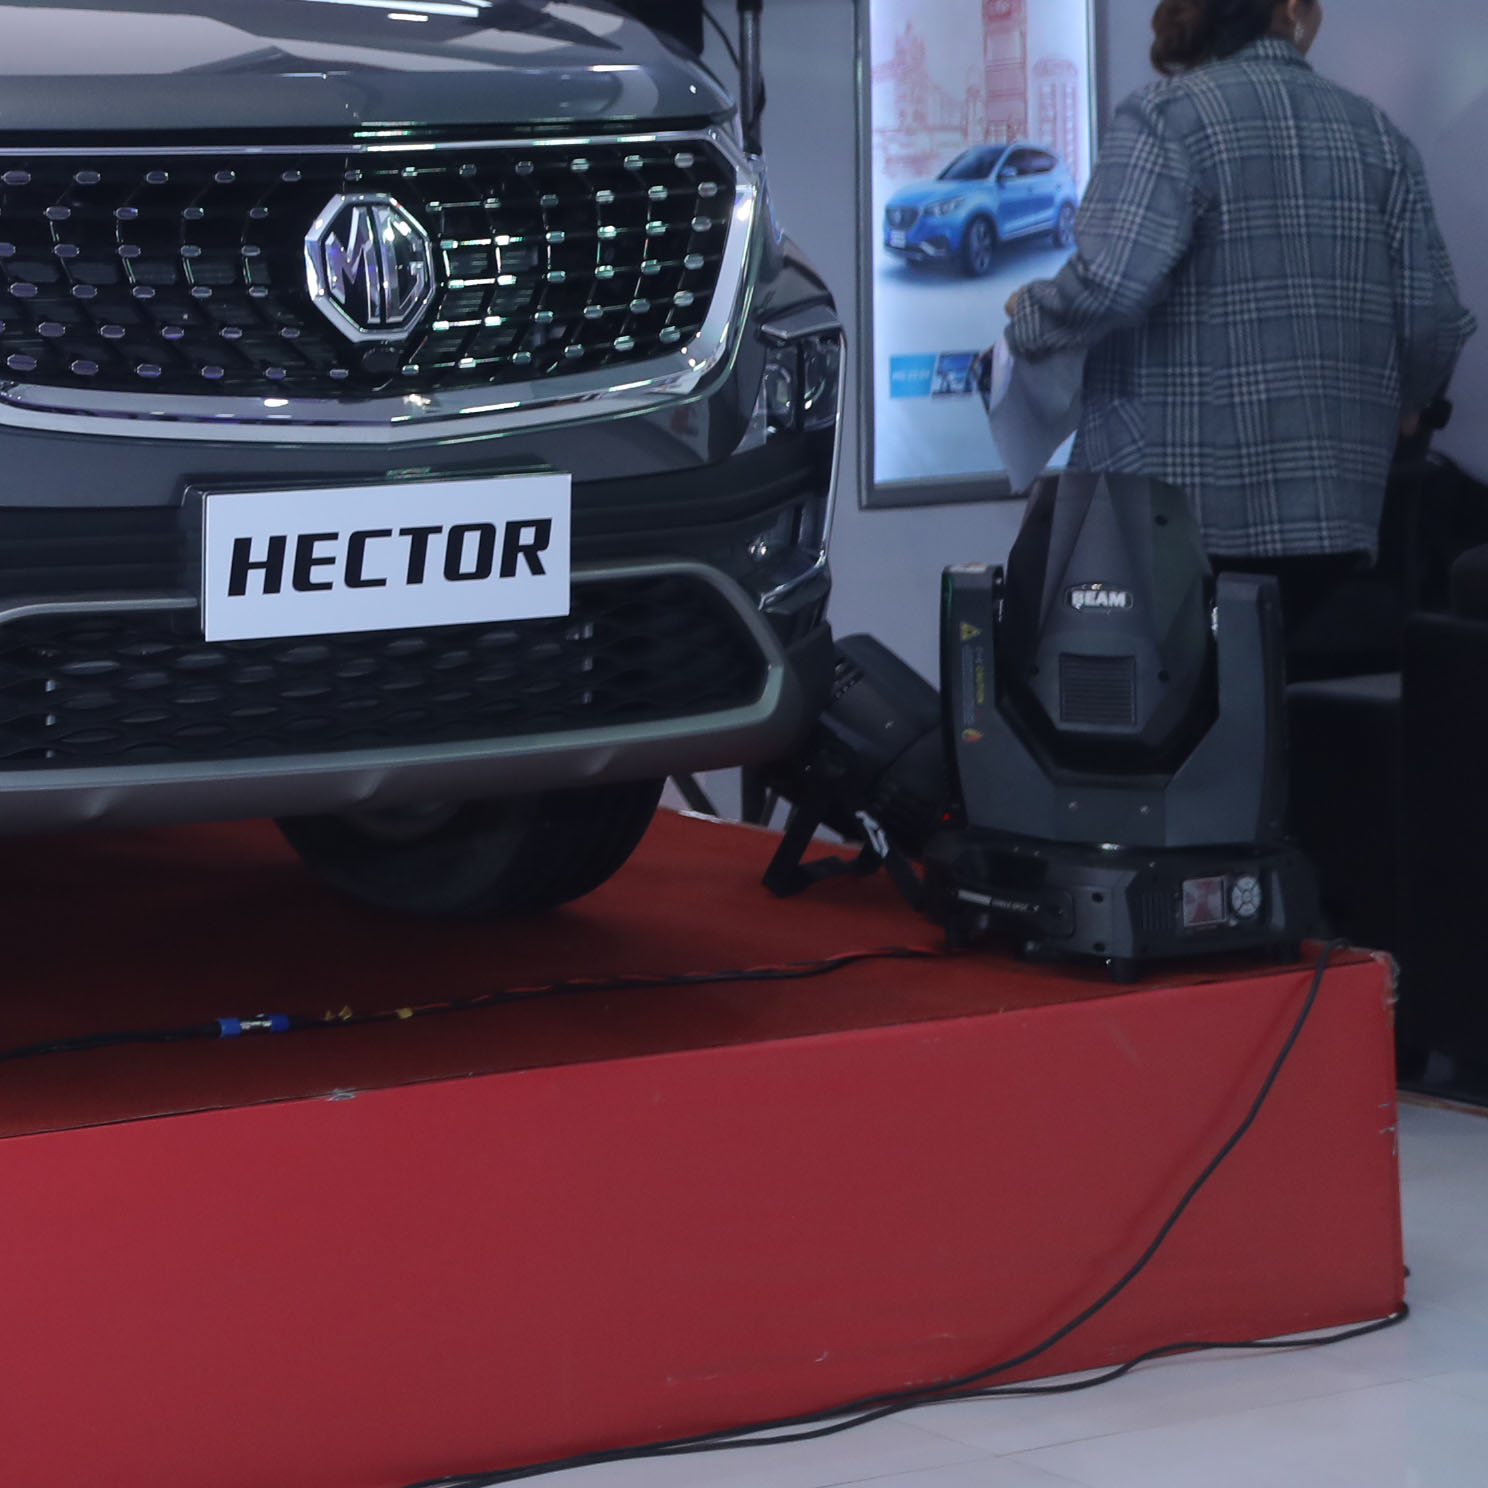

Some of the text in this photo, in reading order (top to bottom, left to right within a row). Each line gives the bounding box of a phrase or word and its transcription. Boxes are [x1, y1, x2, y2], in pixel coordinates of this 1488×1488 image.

[321, 202, 427, 326] MG
[227, 518, 553, 597] HECTOR
[1071, 590, 1127, 608] BEAM
